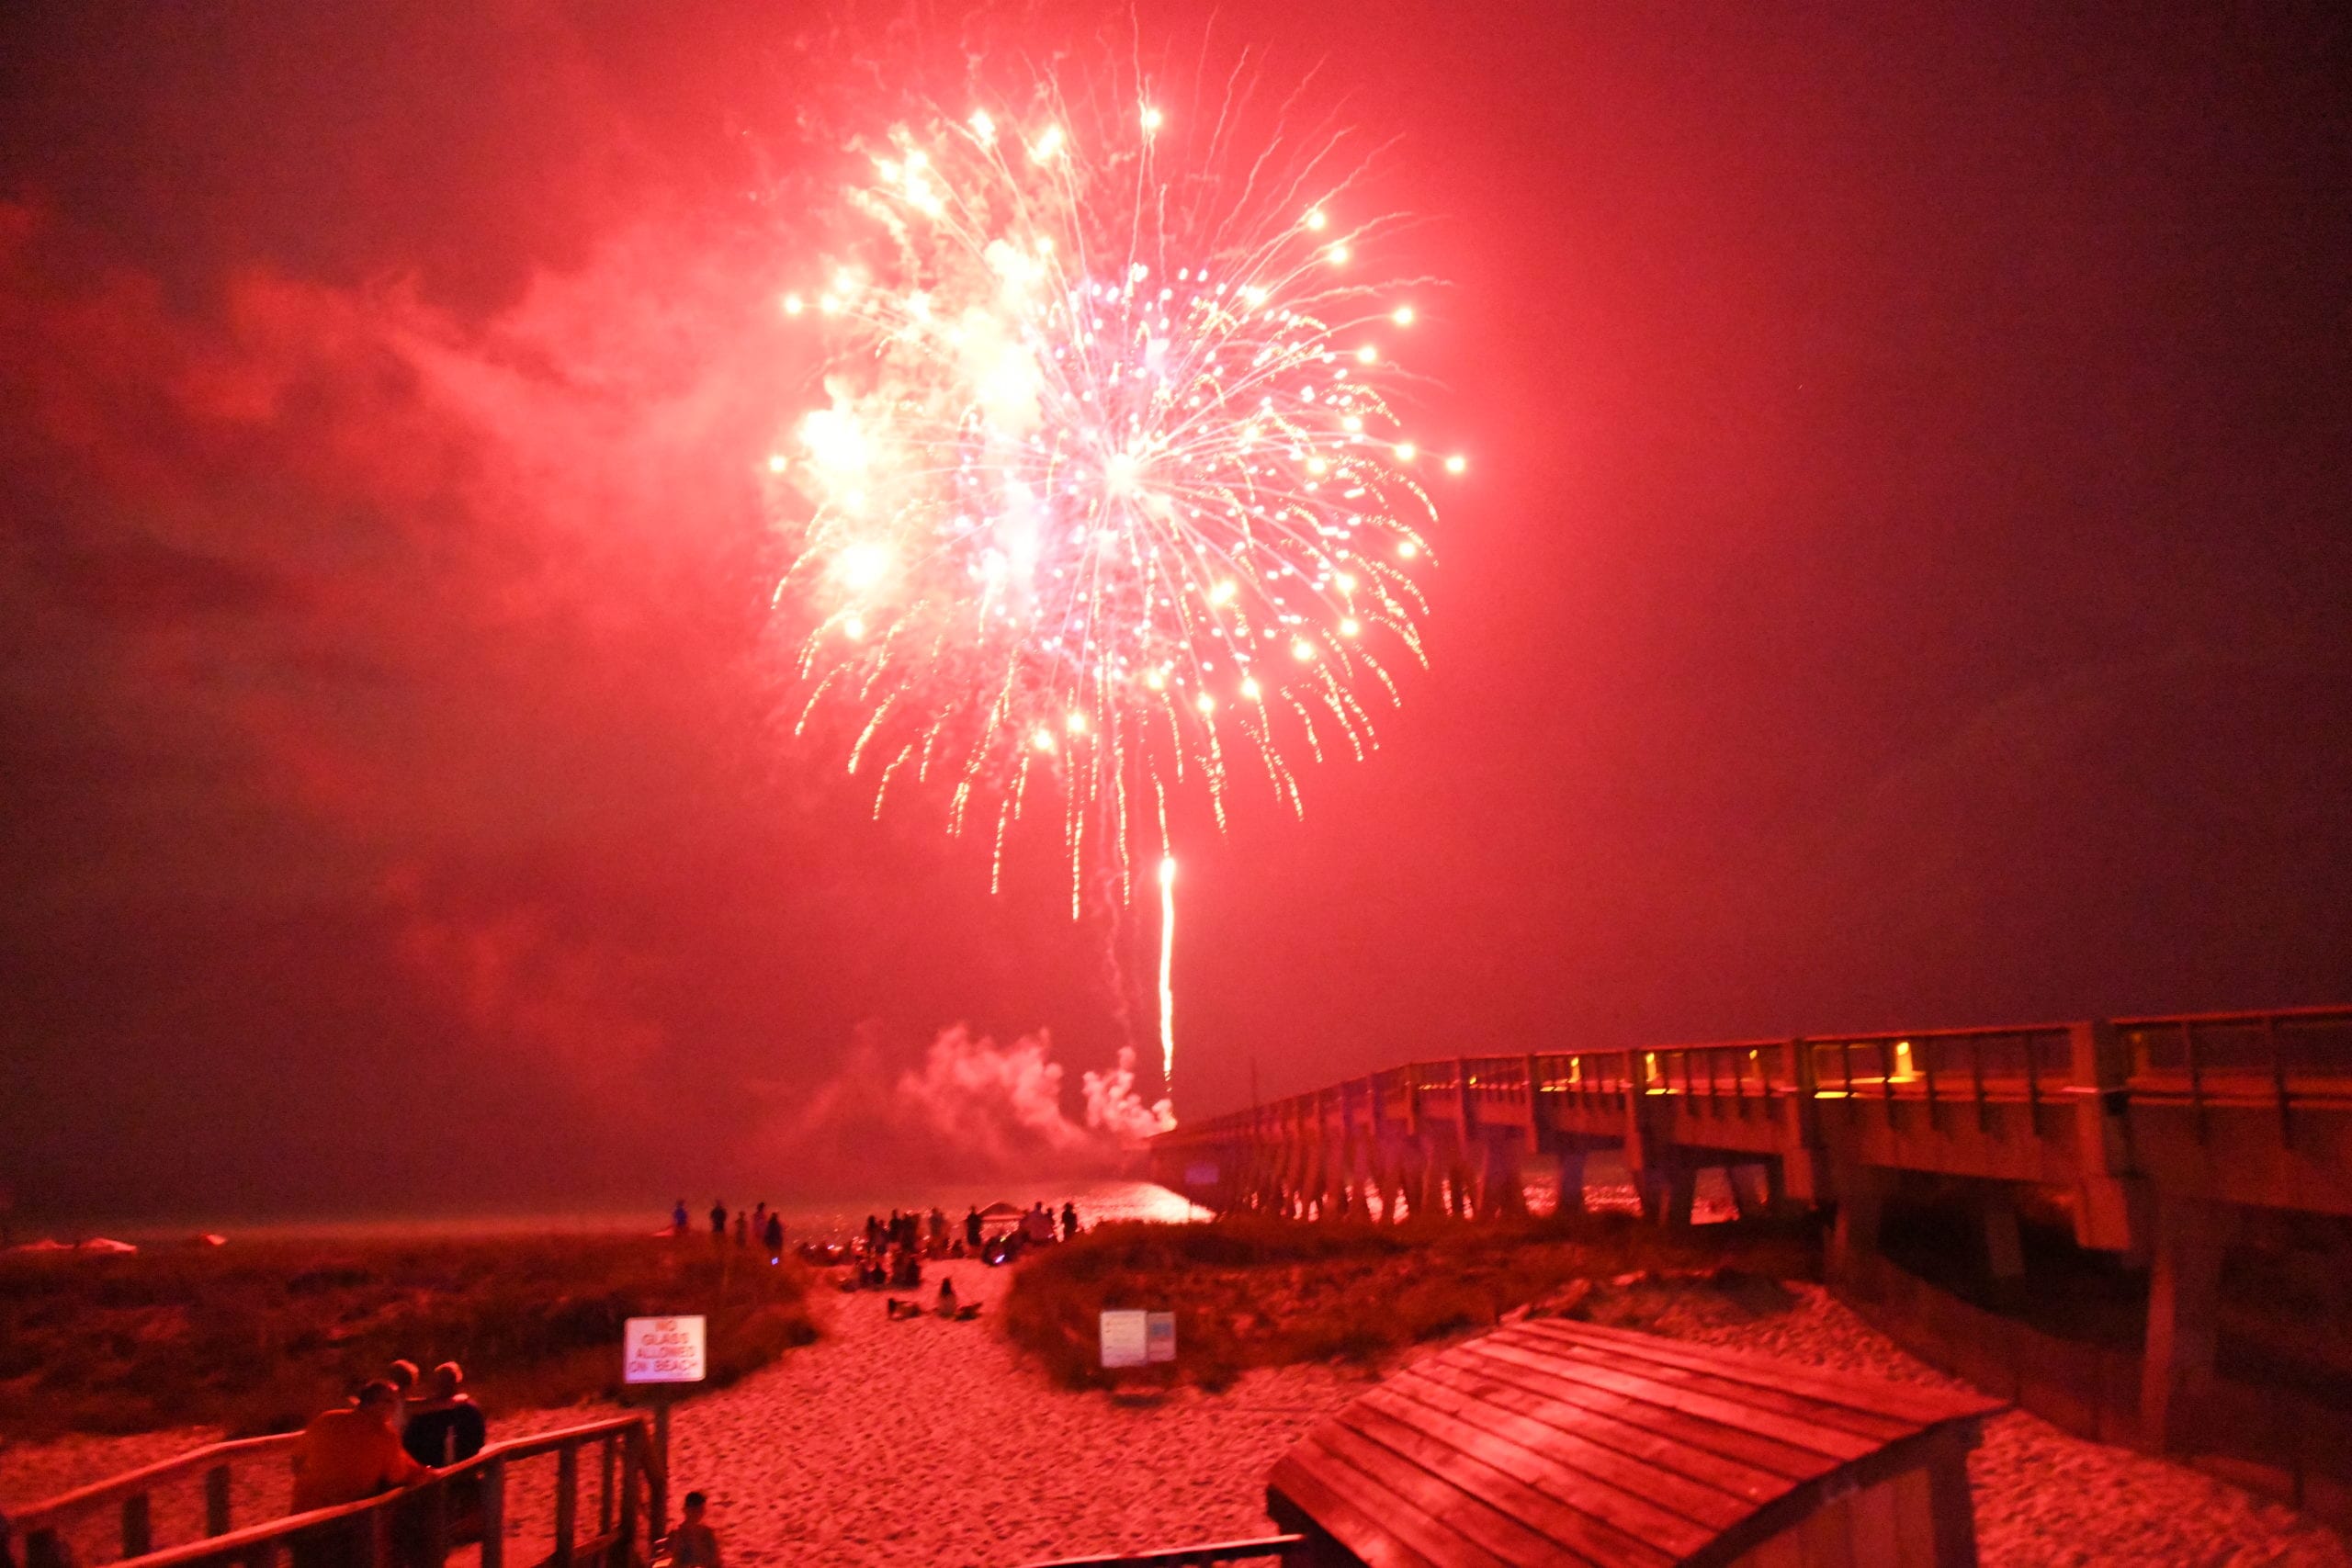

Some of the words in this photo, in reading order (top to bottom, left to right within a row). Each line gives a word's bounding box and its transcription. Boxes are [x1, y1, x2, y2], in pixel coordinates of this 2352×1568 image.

[655, 1318, 677, 1332] NO
[641, 1332, 690, 1346] GLASS
[636, 1346, 696, 1359] ALLOWED
[628, 1360, 649, 1373] ON
[653, 1359, 699, 1373] BEACH
